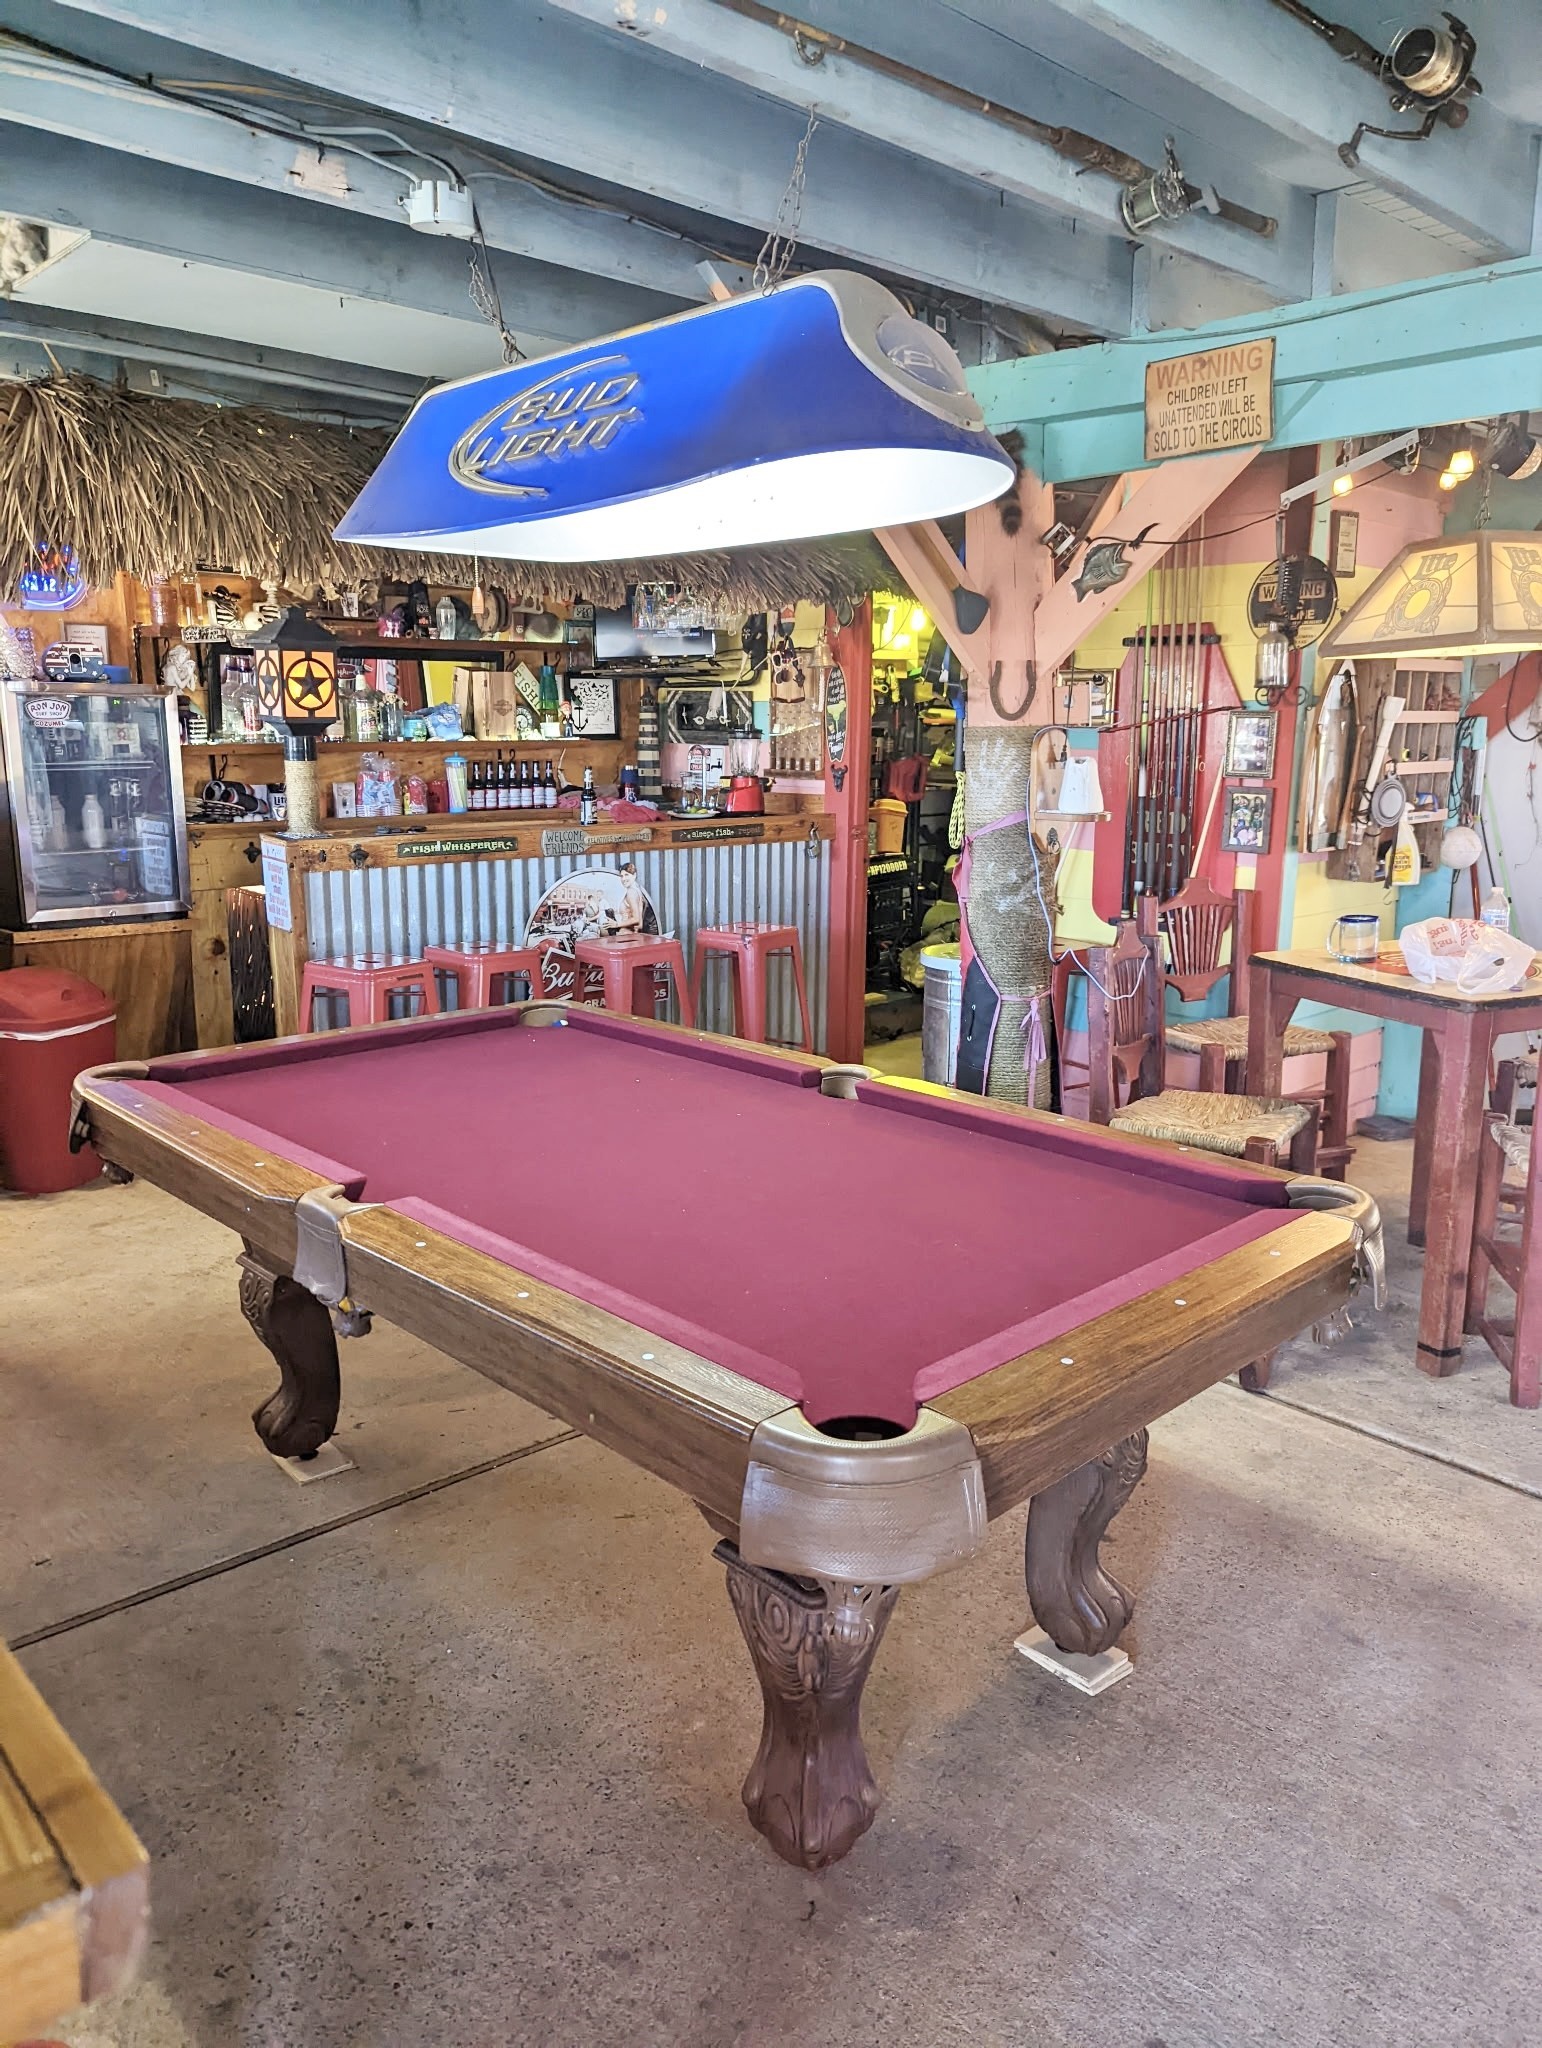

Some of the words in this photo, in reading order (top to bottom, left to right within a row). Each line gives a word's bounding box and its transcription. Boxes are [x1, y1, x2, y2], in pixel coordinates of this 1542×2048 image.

[1156, 346, 1263, 389] WARNING
[501, 373, 640, 431] BUD
[1167, 382, 1219, 405] CHILDREN
[1221, 376, 1248, 395] LEFT
[1159, 402, 1217, 428] UNATTENDED
[1219, 397, 1241, 417] WILL
[1243, 394, 1256, 412] BE
[460, 406, 644, 472] LIGHT
[1154, 428, 1180, 452] SOLD
[1183, 426, 1197, 448] TO
[1199, 421, 1219, 444] THE
[1221, 414, 1263, 441] CIRCUS
[1412, 553, 1458, 580] Lite
[1263, 581, 1323, 599] WING
[31, 702, 48, 712] RON
[49, 702, 67, 712] JON
[442, 841, 504, 852] WHISPERER
[544, 842, 585, 856] FRIENDS
[546, 830, 584, 844] WELCOME
